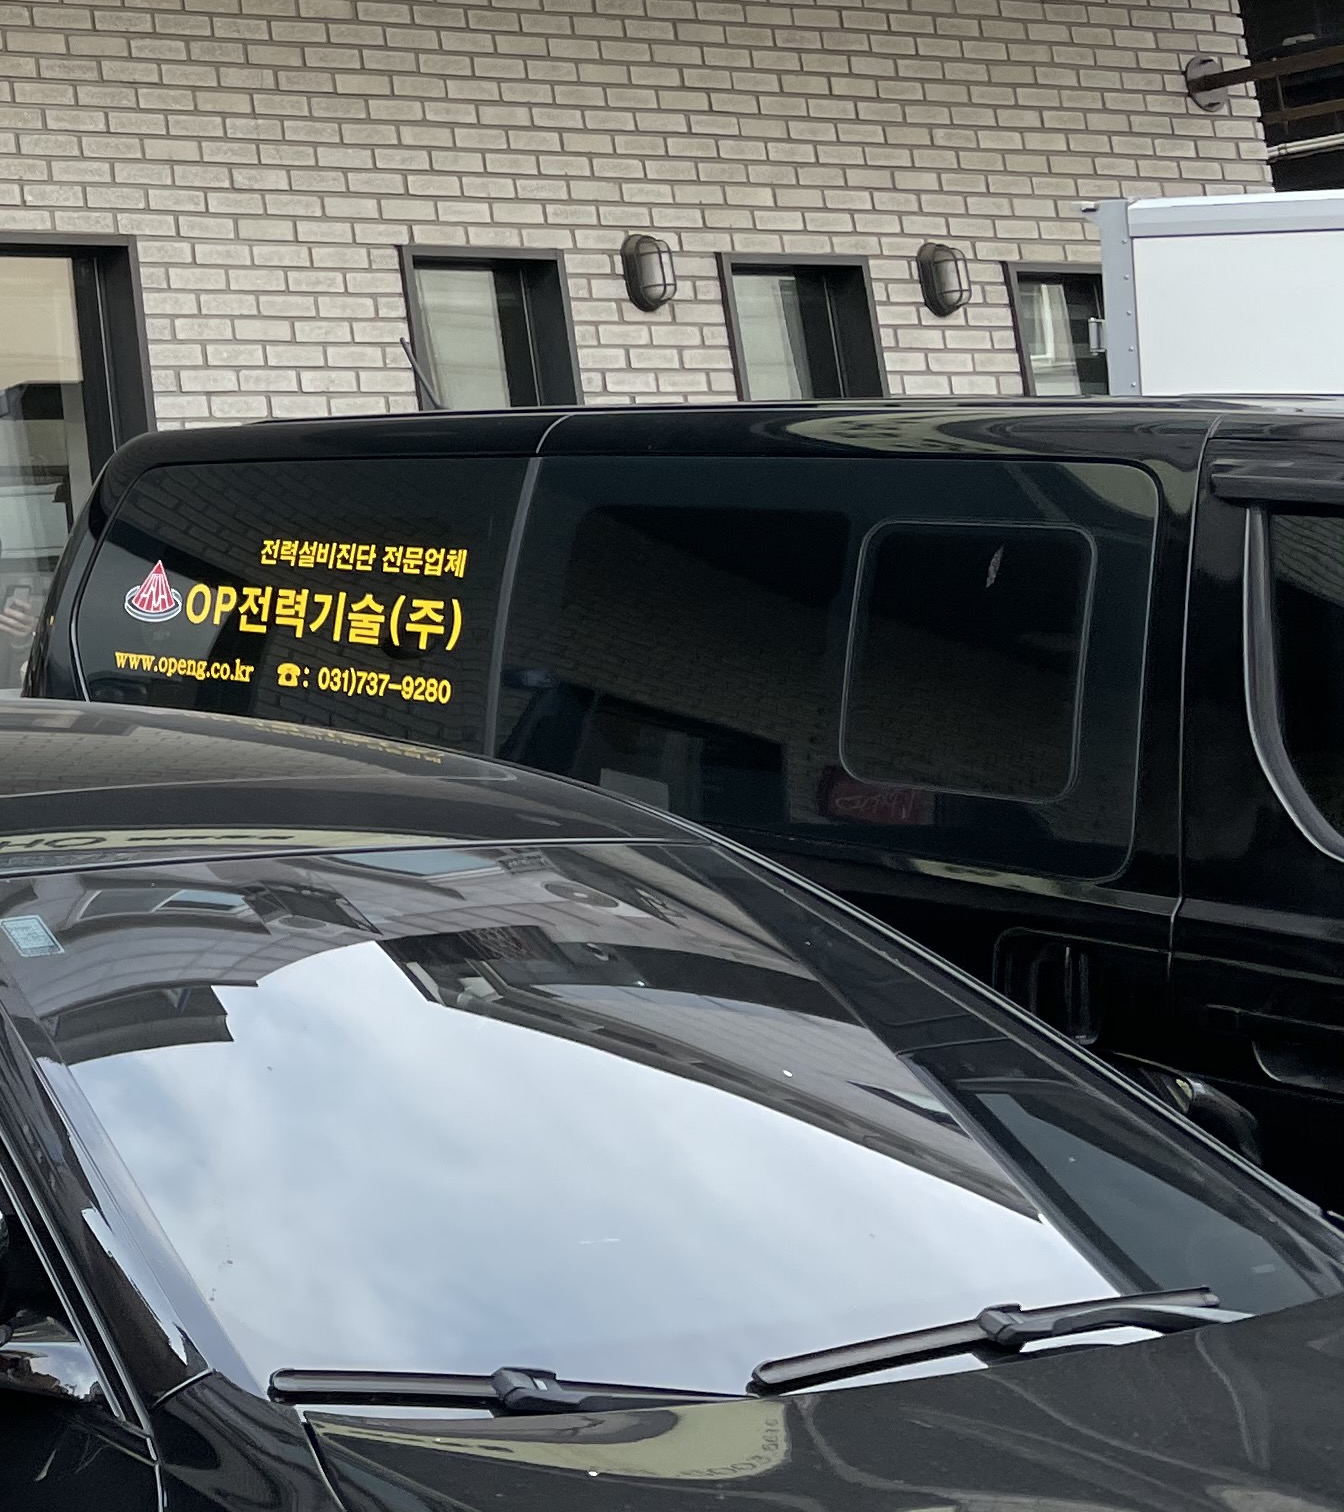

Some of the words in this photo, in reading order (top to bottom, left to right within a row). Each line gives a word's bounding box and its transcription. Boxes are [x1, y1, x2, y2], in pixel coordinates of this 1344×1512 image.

[260, 538, 376, 570] 전력설비진단
[381, 544, 468, 579] 전문업체
[185, 582, 463, 652] OP전력기술(주)
[114, 651, 255, 683] www.openg.co.kr
[317, 666, 452, 705] 031)737-9280
